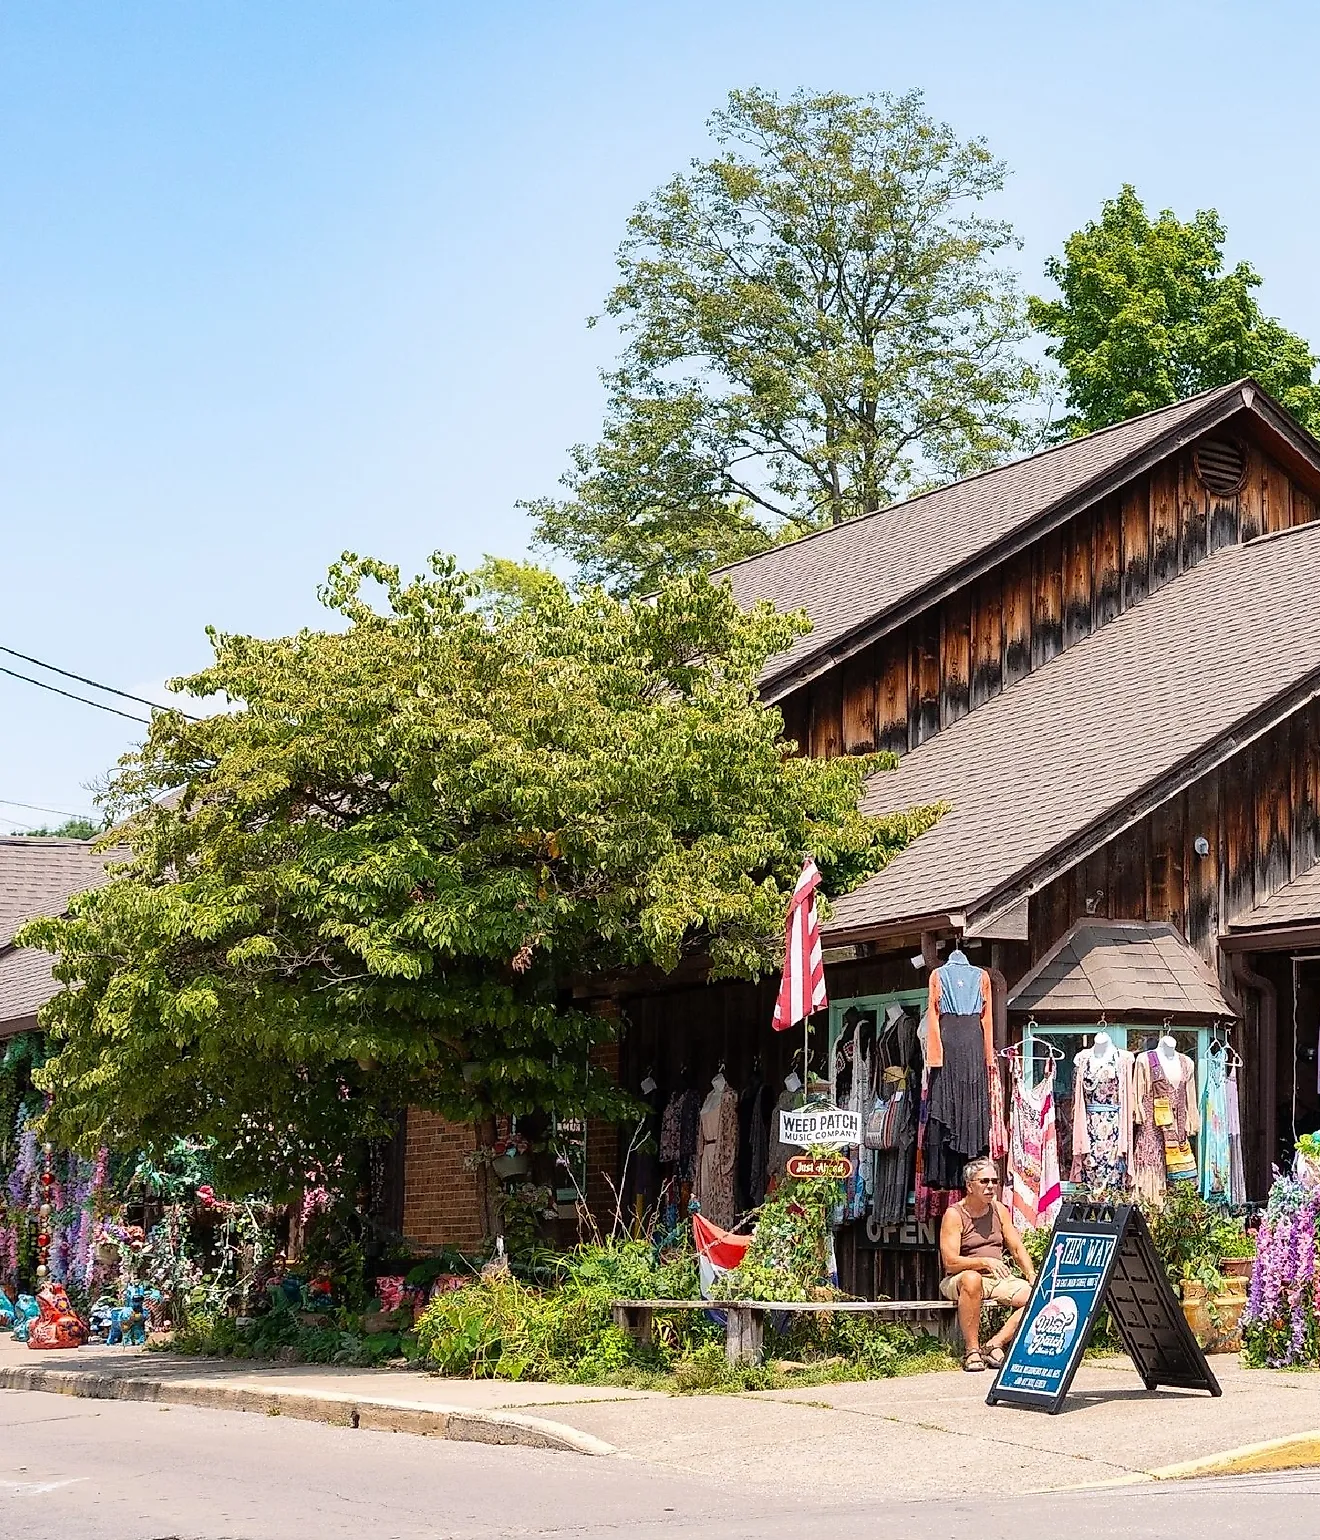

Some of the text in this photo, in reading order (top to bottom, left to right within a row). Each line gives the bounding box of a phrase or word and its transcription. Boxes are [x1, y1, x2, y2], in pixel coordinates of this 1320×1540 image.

[783, 1114, 858, 1132] WEED PATCH
[785, 1130, 857, 1141] MUSIC COMPANY
[796, 1162, 845, 1173] Just Ahad
[866, 1215, 936, 1244] OPEN
[1060, 1238, 1114, 1267] THIS WAY
